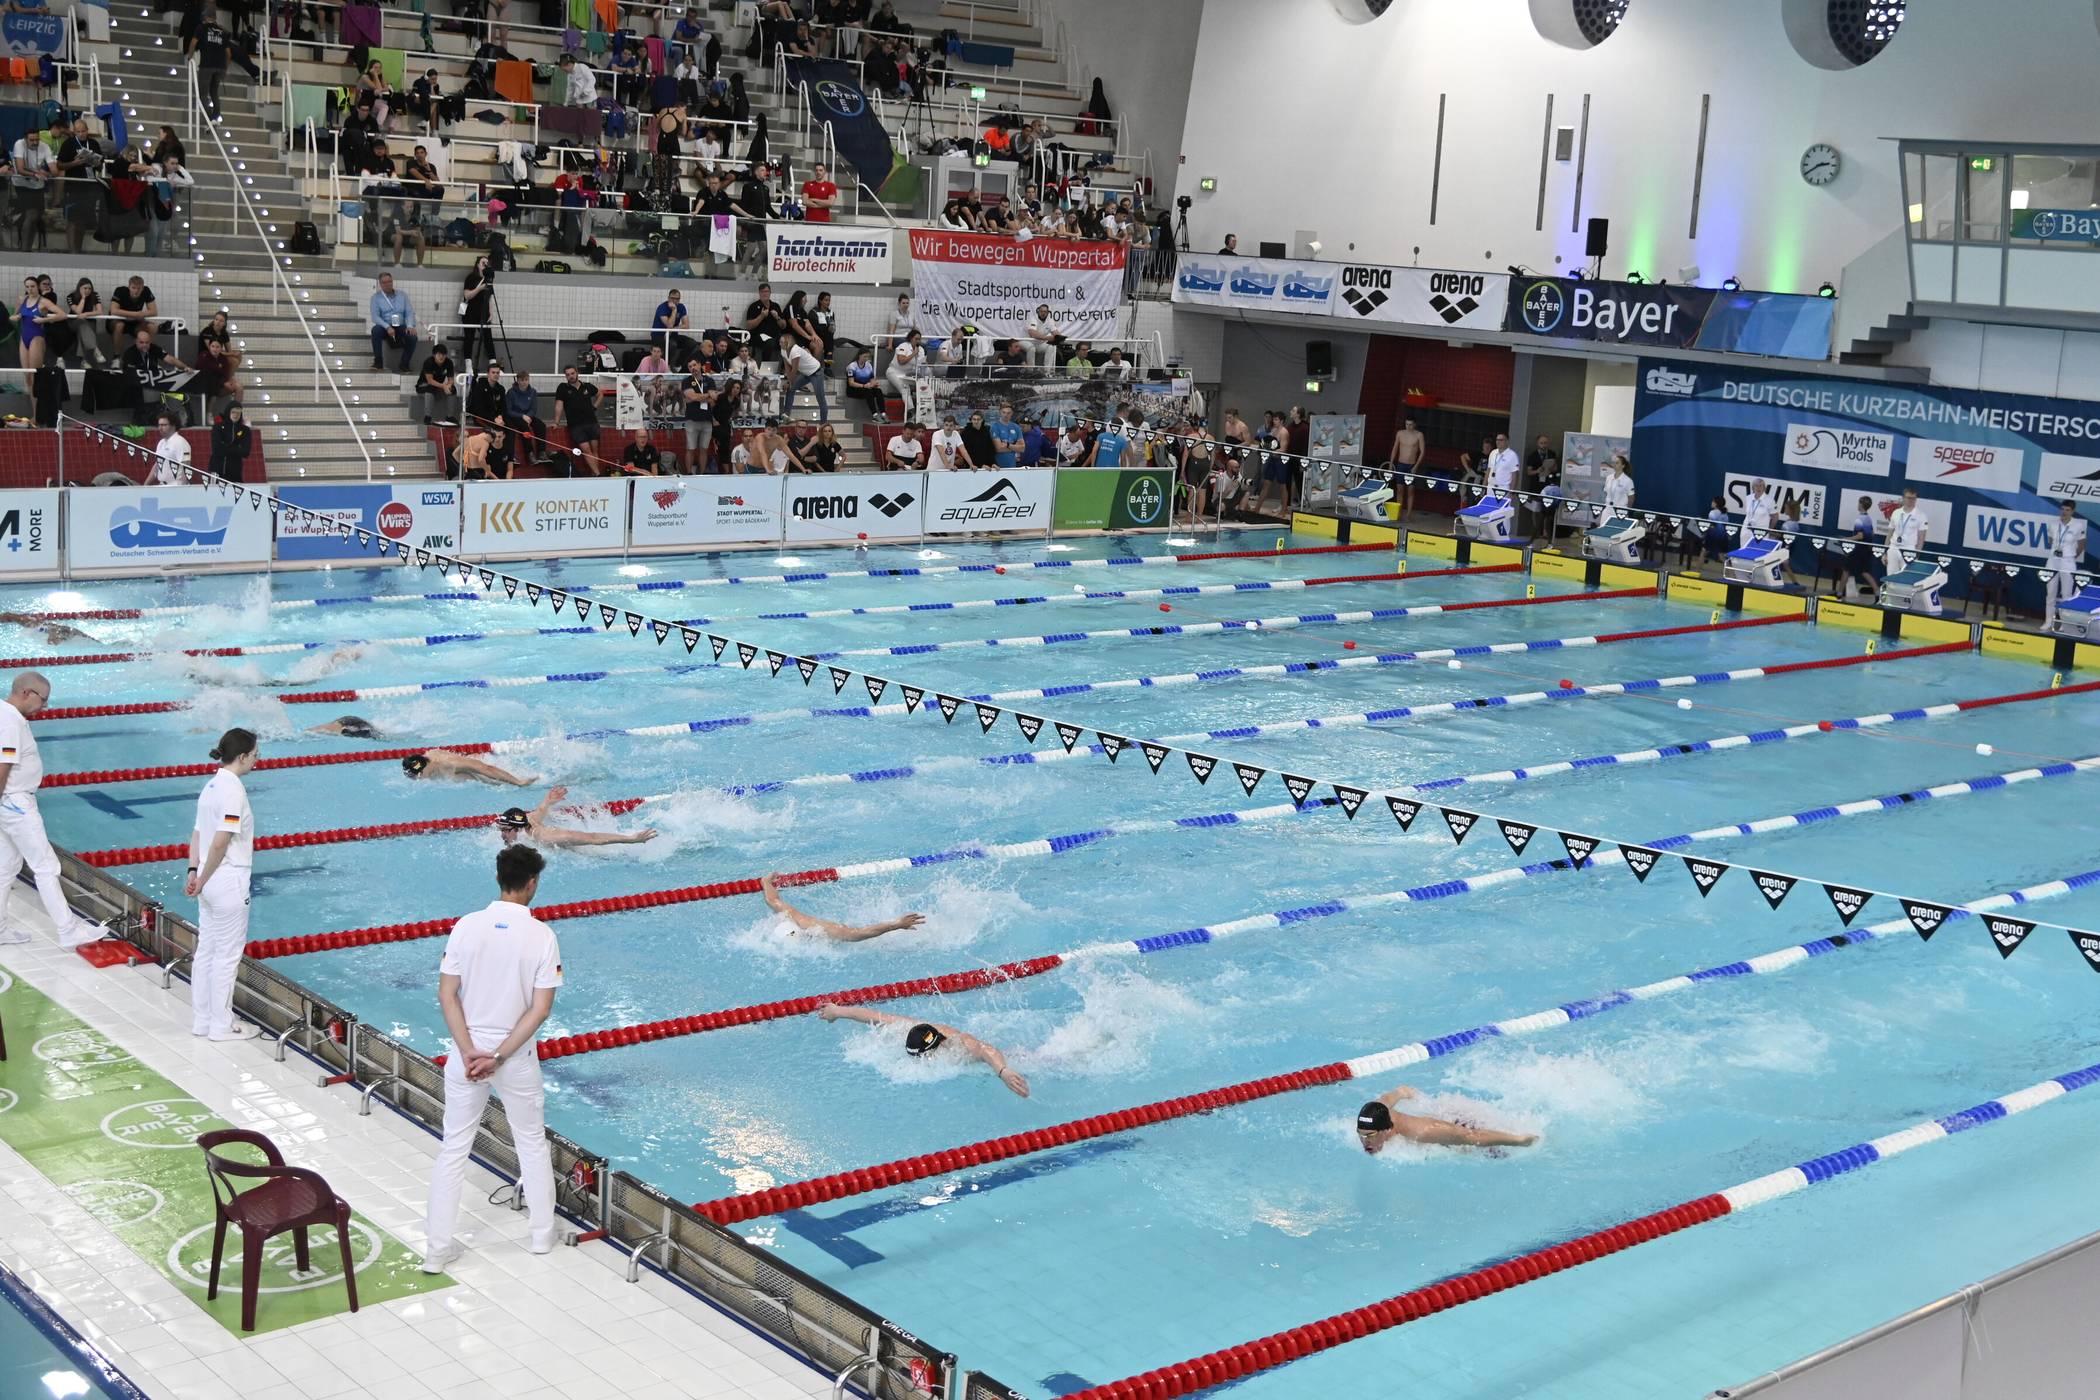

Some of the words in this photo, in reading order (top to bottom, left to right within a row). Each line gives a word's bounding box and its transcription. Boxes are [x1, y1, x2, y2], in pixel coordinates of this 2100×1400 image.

[9, 19, 56, 35] LEIPZIG
[775, 235, 887, 258] hartmann
[912, 236, 942, 257] Wir
[950, 238, 1025, 265] bewegen
[1032, 244, 1115, 269] Wuppertal
[773, 258, 856, 272] Bürotechnik
[1342, 266, 1392, 289] arena
[1430, 272, 1484, 296] arena
[957, 280, 1066, 300] Stadtsportbund
[1075, 285, 1085, 300] &
[1526, 302, 1560, 312] BAYER
[1537, 285, 1548, 328] BAYER
[1571, 288, 1679, 339] Bayer
[1722, 381, 1833, 411] DEUTSCHE
[1841, 432, 1887, 450] Myrtha
[1840, 446, 1874, 463] Pools
[1933, 445, 1995, 465] speedo
[535, 498, 609, 515] KONTAKT
[792, 495, 858, 519] arena
[1130, 495, 1160, 504] BAYER
[1141, 480, 1149, 519] BAYER
[1812, 490, 1822, 520] MORE
[284, 513, 299, 521] En
[338, 512, 357, 520] Duo
[940, 502, 1037, 524] aquafeel
[30, 509, 42, 552] MORE
[109, 497, 234, 549] dsv
[284, 526, 298, 534] für
[535, 516, 609, 532] STIFTUNG
[423, 535, 453, 549] AWG
[110, 550, 145, 558] Deutscher
[1020, 718, 1038, 729] arena
[1060, 727, 1076, 738] arena
[1103, 737, 1119, 748] arena
[1146, 746, 1164, 759] arena
[1192, 757, 1210, 769] arena
[1240, 767, 1258, 780] arena
[1288, 777, 1308, 791] arena
[1340, 788, 1361, 802] arena
[1392, 800, 1414, 814] arena
[1448, 813, 1470, 826] arena
[1505, 824, 1529, 838] arena
[1567, 838, 1591, 851] arena
[1627, 850, 1652, 864] arena
[1692, 862, 1718, 878] arena
[1759, 876, 1786, 890] arena
[1834, 890, 1862, 906] arena
[1910, 905, 1941, 922] arena
[1992, 920, 2023, 936] arena
[2080, 937, 2100, 950] are
[881, 1319, 919, 1343] OMEGA
